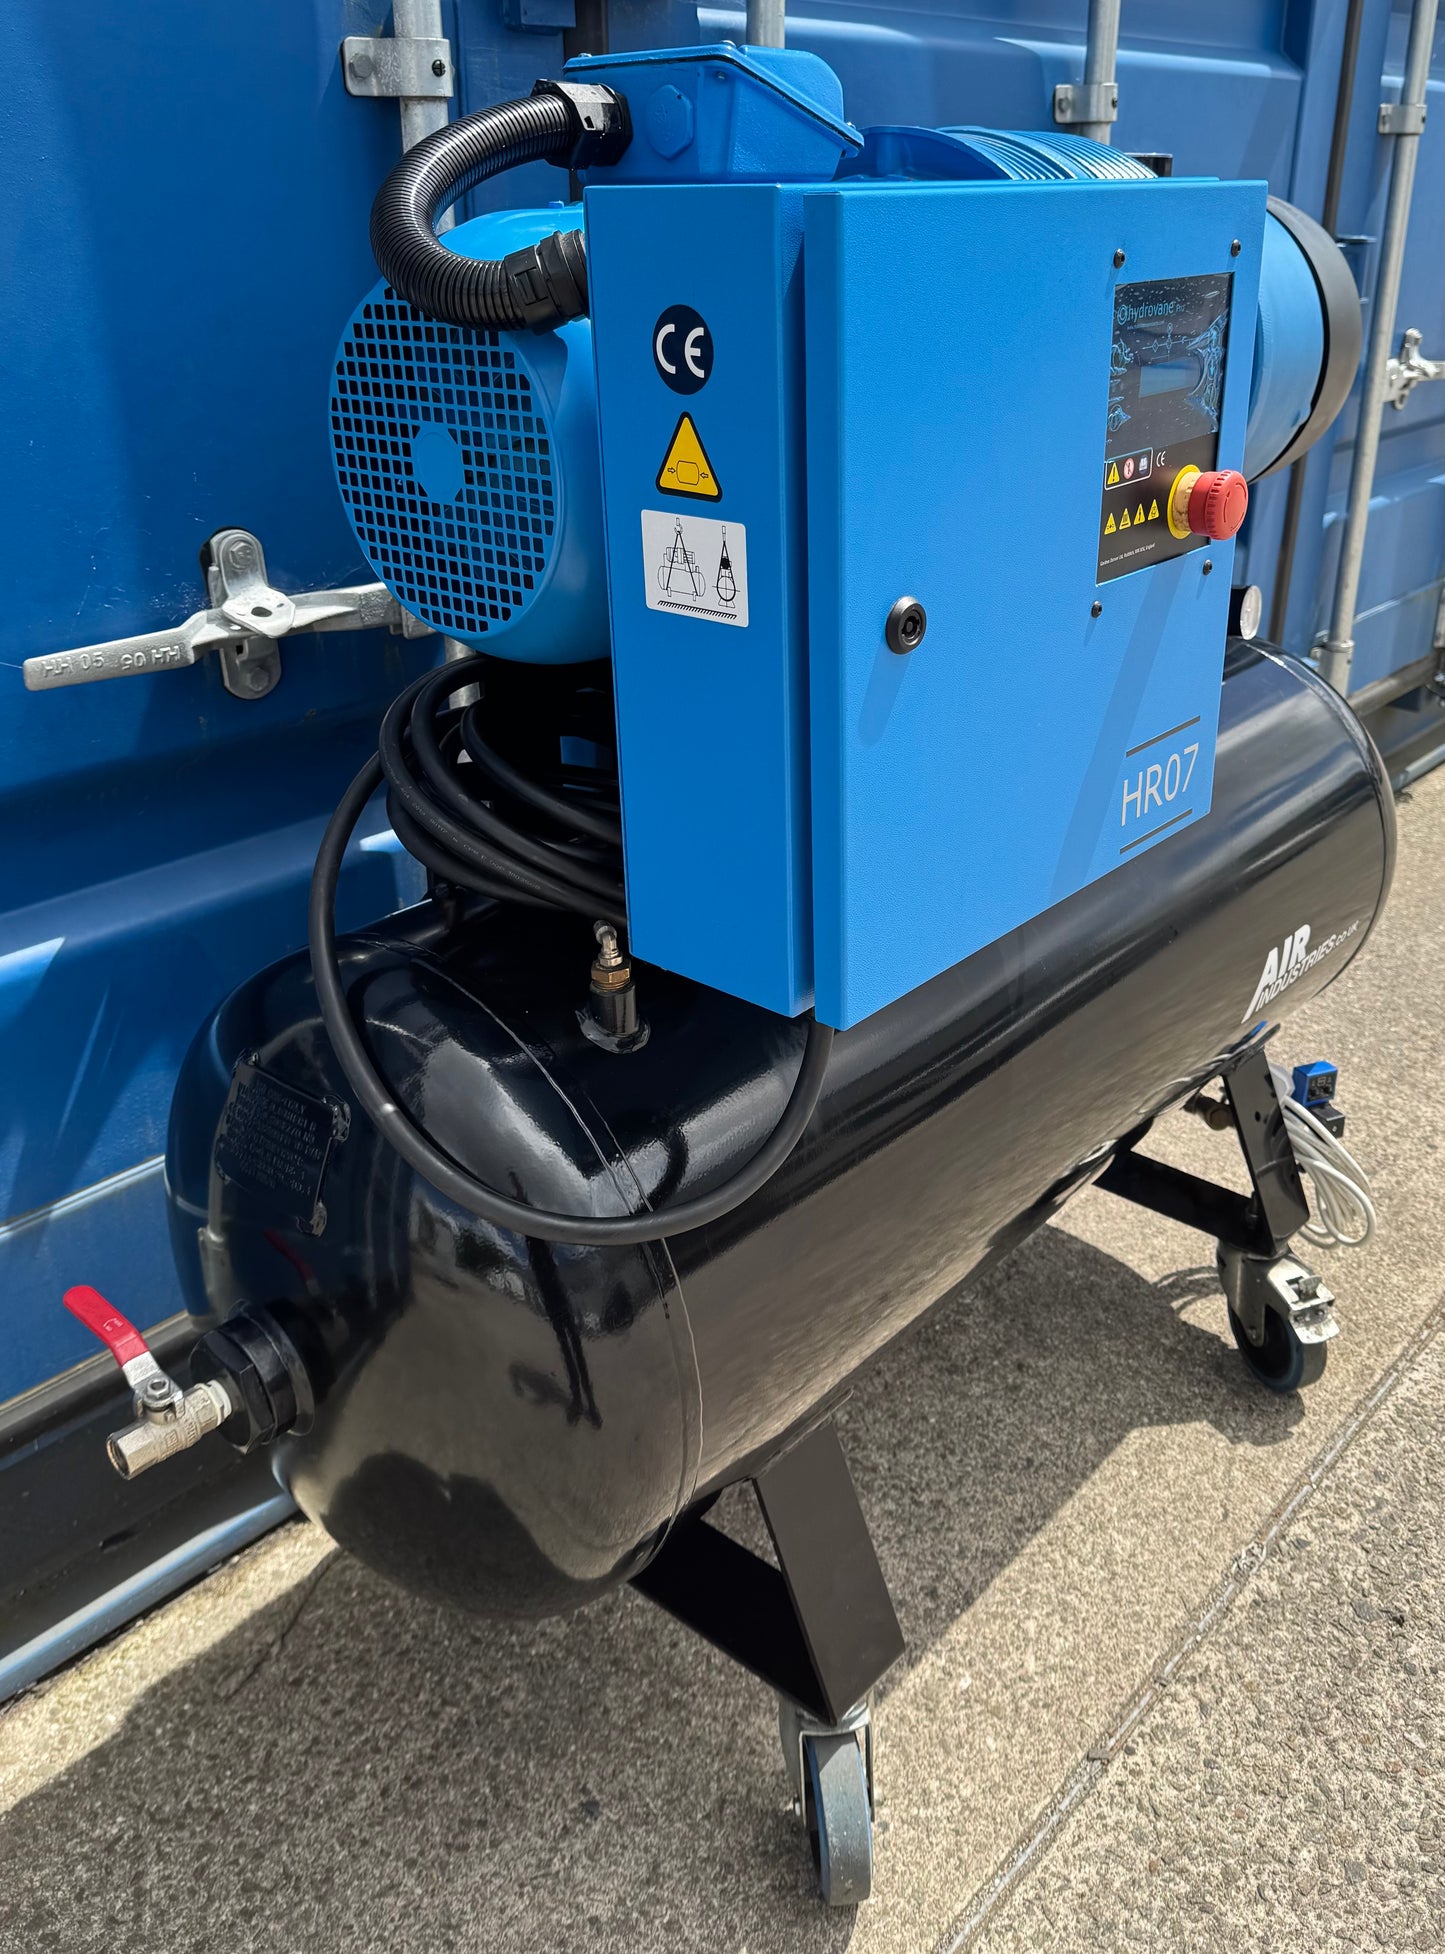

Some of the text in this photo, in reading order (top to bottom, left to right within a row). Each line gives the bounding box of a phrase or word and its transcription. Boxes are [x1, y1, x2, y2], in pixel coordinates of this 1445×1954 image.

[1127, 301, 1175, 322] hydrovane
[656, 323, 705, 379] CE
[1156, 450, 1166, 467] CE
[1121, 742, 1199, 827] HR07
[1241, 924, 1311, 1025] AIR
